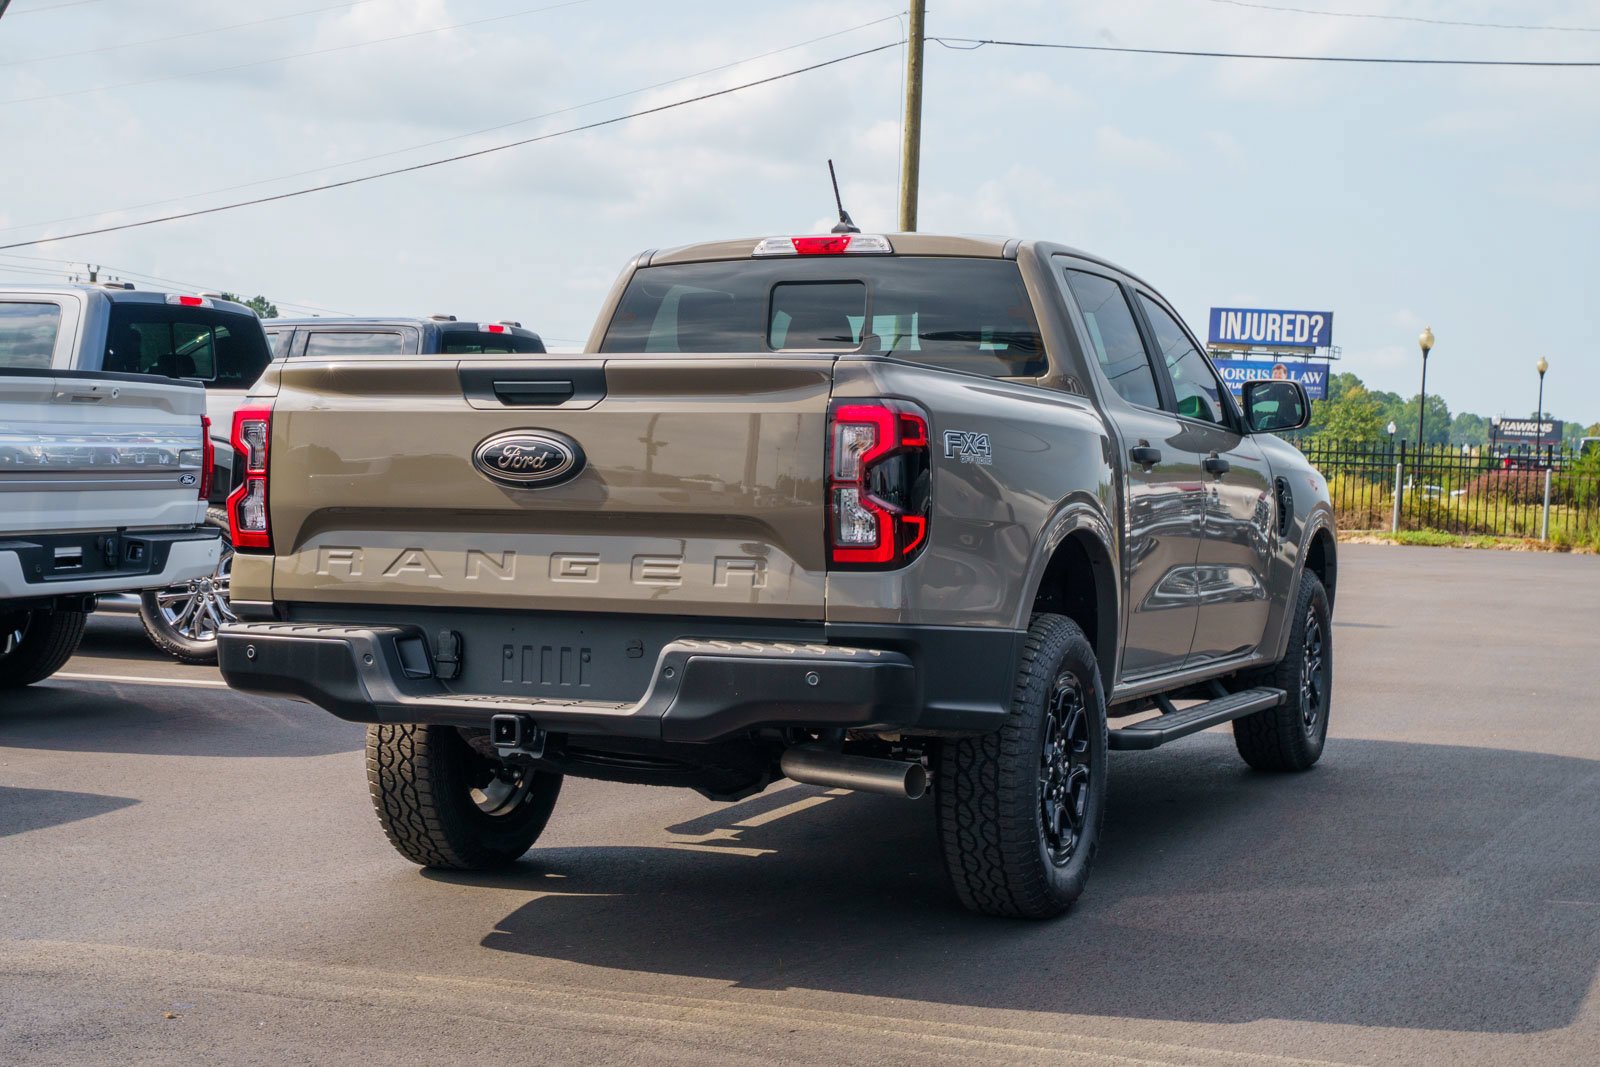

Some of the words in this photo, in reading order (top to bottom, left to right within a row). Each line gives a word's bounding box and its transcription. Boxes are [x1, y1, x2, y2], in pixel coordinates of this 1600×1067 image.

[1219, 311, 1324, 343] INJURED?
[1290, 370, 1323, 384] LAW
[1500, 421, 1553, 433] HAWKINS
[498, 444, 549, 469] Ford
[943, 429, 991, 458] FX4
[315, 545, 769, 588] RANGER
